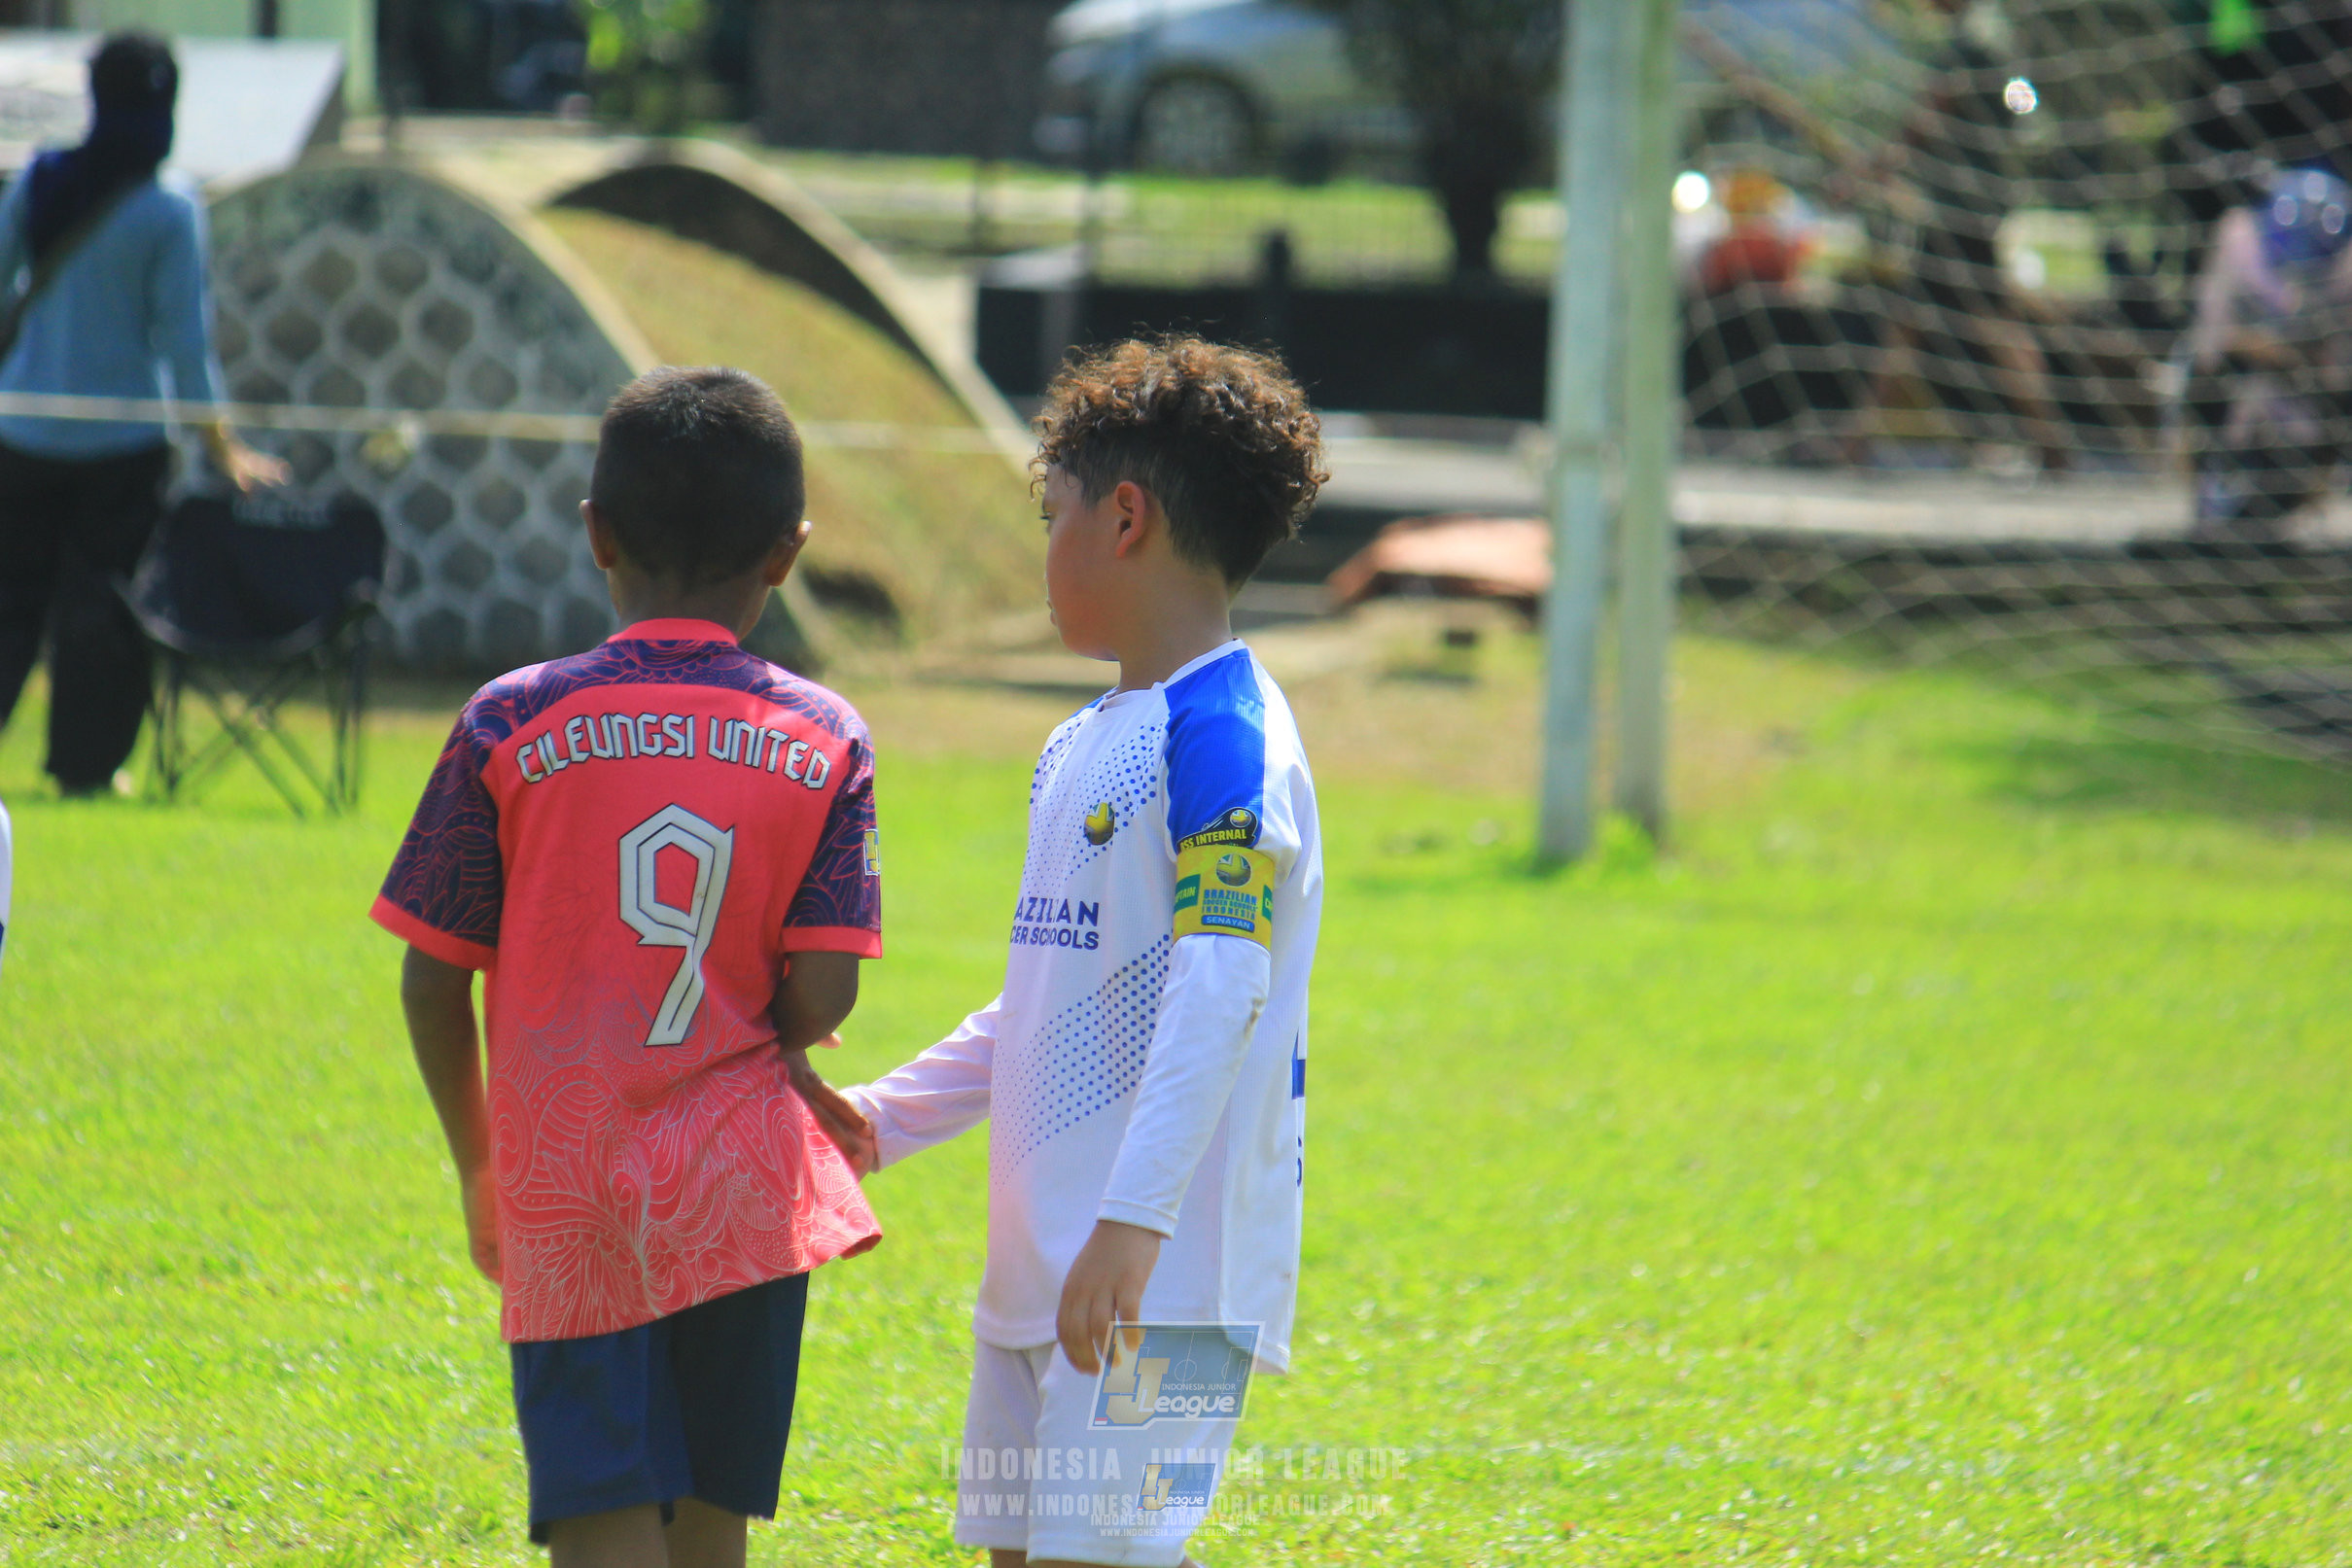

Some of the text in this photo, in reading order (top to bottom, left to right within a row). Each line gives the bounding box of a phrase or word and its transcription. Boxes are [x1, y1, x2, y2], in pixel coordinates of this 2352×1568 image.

[515, 713, 831, 789] CILEUNGSI UNITED
[1196, 828, 1247, 846] INTERNAL
[1204, 889, 1257, 905] BRAZILIAN
[618, 803, 735, 1047] 9
[1207, 916, 1250, 929] SENAYAN
[1029, 926, 1099, 950] SCOOLS
